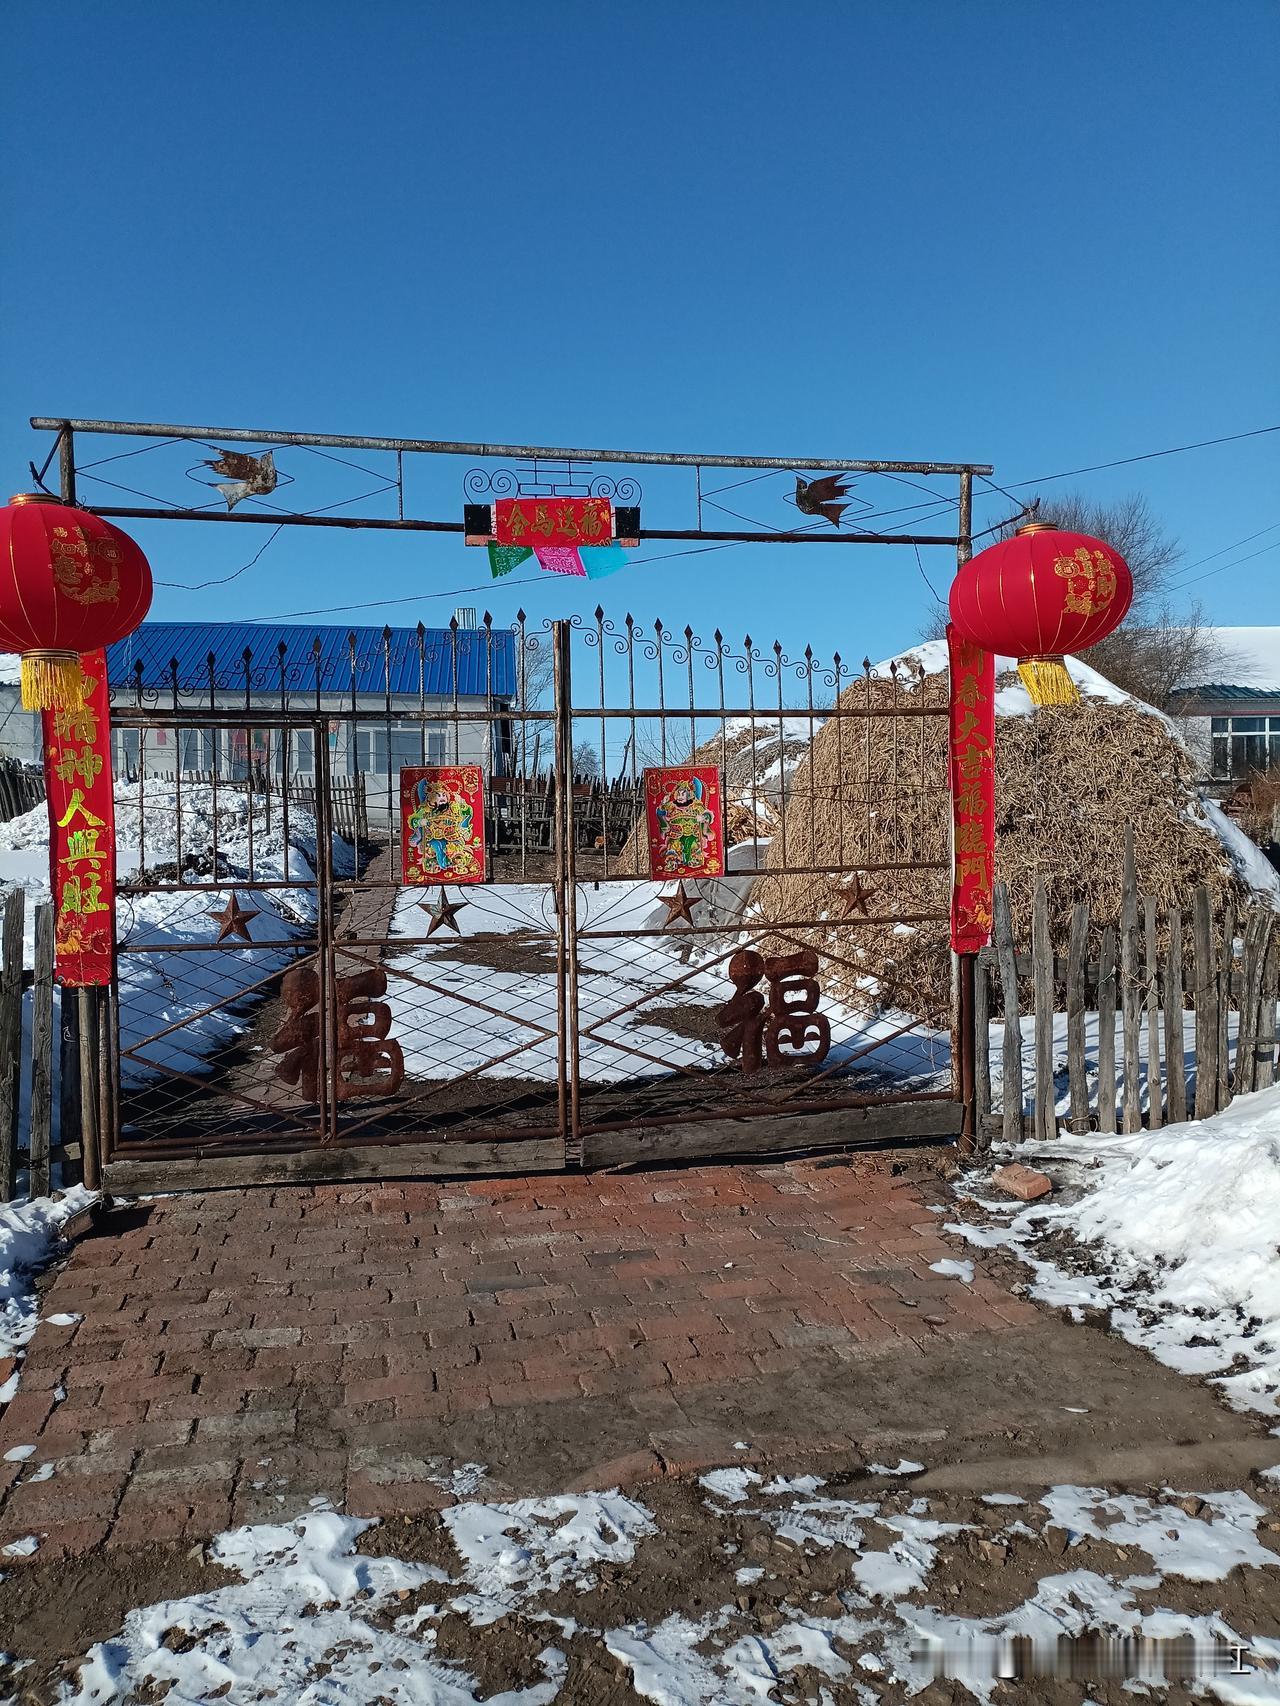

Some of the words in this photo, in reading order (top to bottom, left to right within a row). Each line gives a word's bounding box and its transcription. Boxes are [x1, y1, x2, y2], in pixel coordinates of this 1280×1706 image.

[54, 652, 110, 914] 精神人興旺
[269, 967, 405, 1102] 福
[715, 950, 831, 1073] 福
